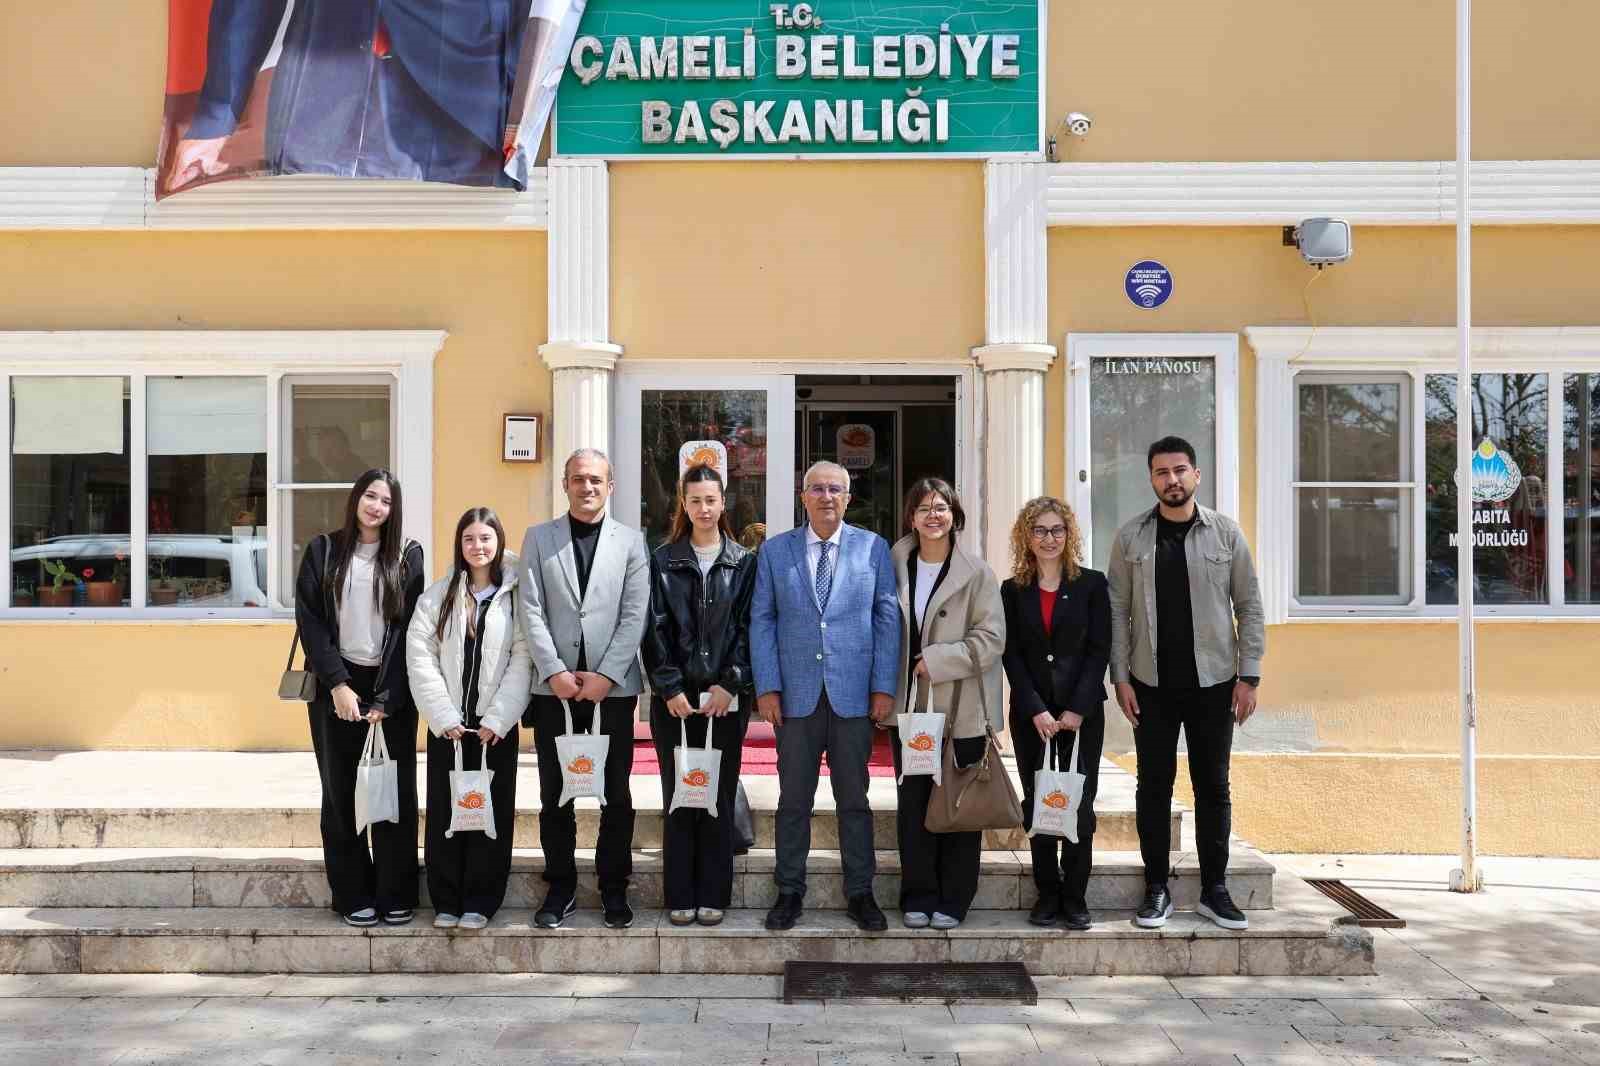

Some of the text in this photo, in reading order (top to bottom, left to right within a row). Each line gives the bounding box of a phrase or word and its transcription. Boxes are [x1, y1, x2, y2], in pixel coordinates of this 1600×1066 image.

[770, 3, 821, 29] T.C.
[570, 23, 1020, 86] ÇAMELİ BELEDİYE
[641, 87, 949, 150] BAŞKANLIĞI
[1104, 358, 1201, 374] İLAN PANOSU
[1449, 530, 1528, 546] MDÜRLÜĞÜ
